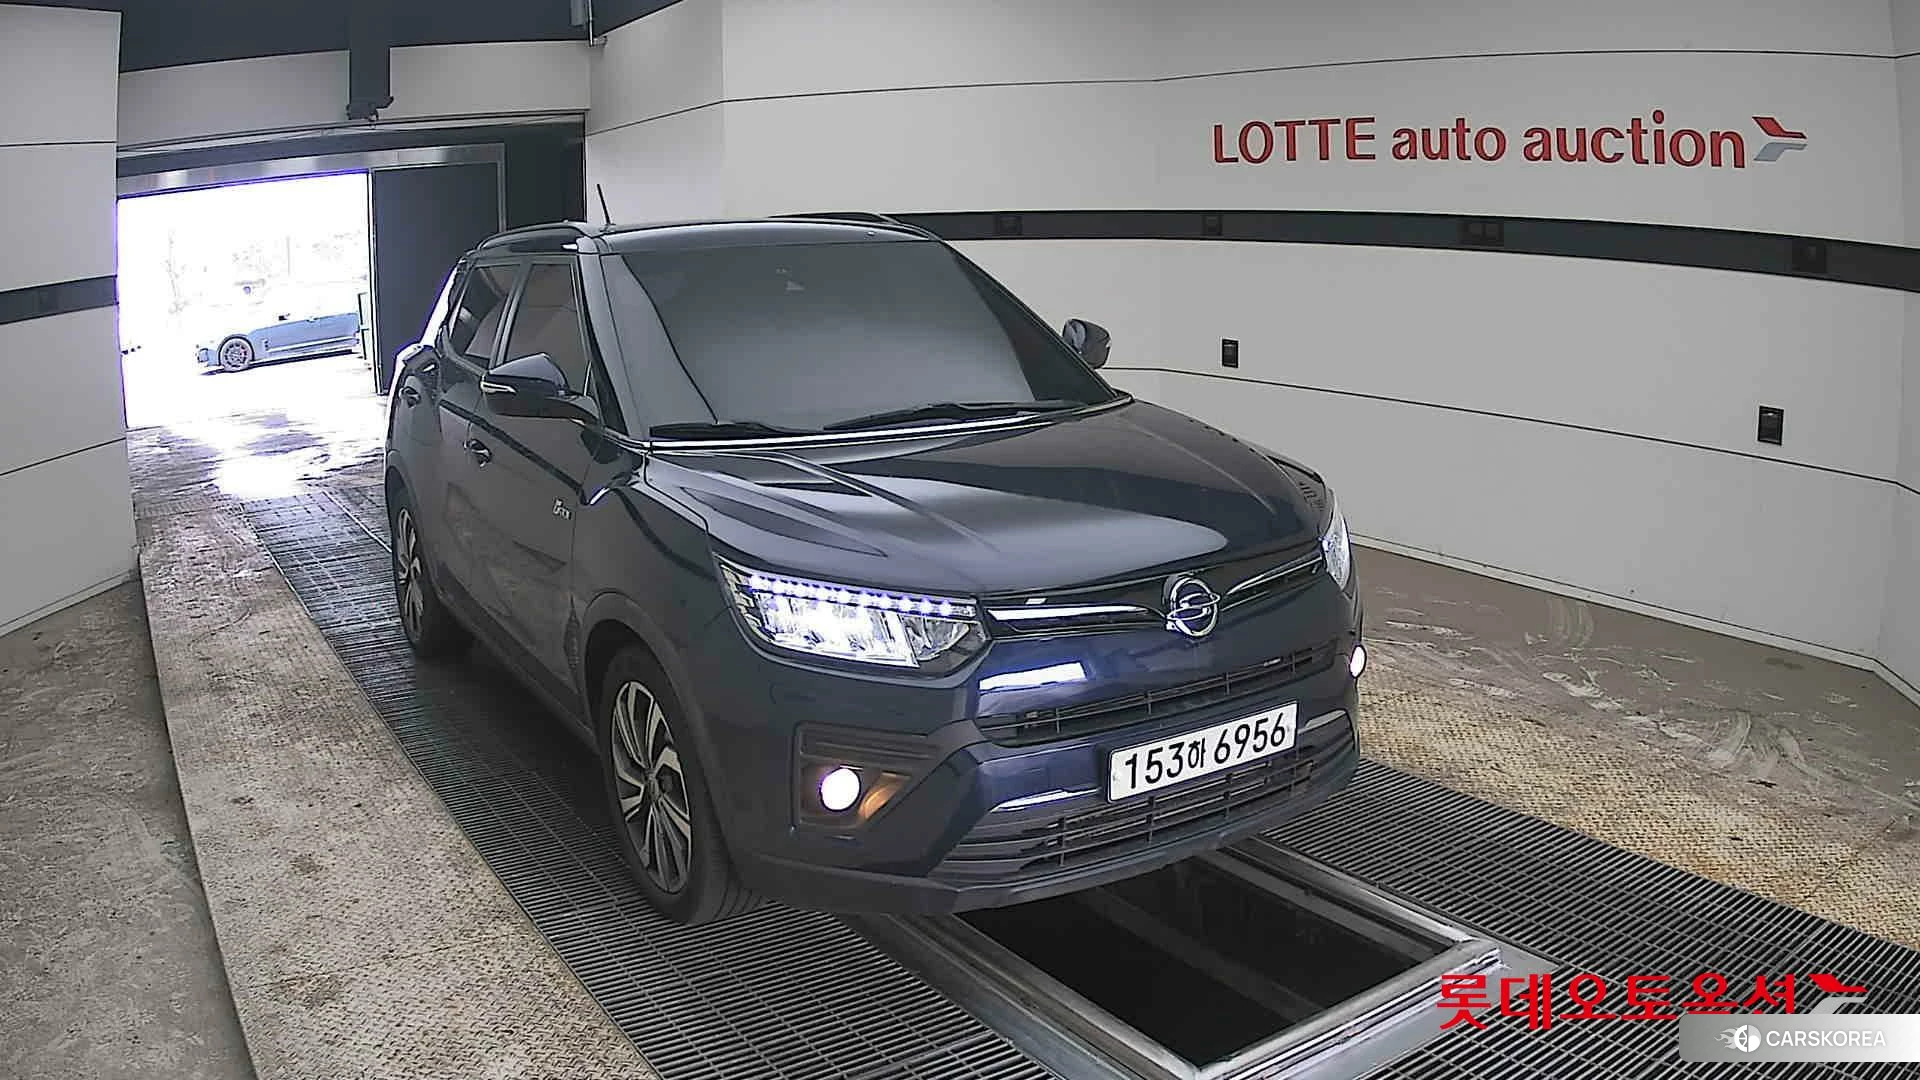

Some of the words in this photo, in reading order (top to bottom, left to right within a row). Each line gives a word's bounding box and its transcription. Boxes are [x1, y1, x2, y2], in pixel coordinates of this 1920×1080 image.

[1213, 116, 1376, 164] LOTTE
[1392, 118, 1506, 161] auto
[1523, 110, 1745, 169] auction
[1125, 737, 1206, 789] 153하
[1213, 712, 1286, 764] 6956
